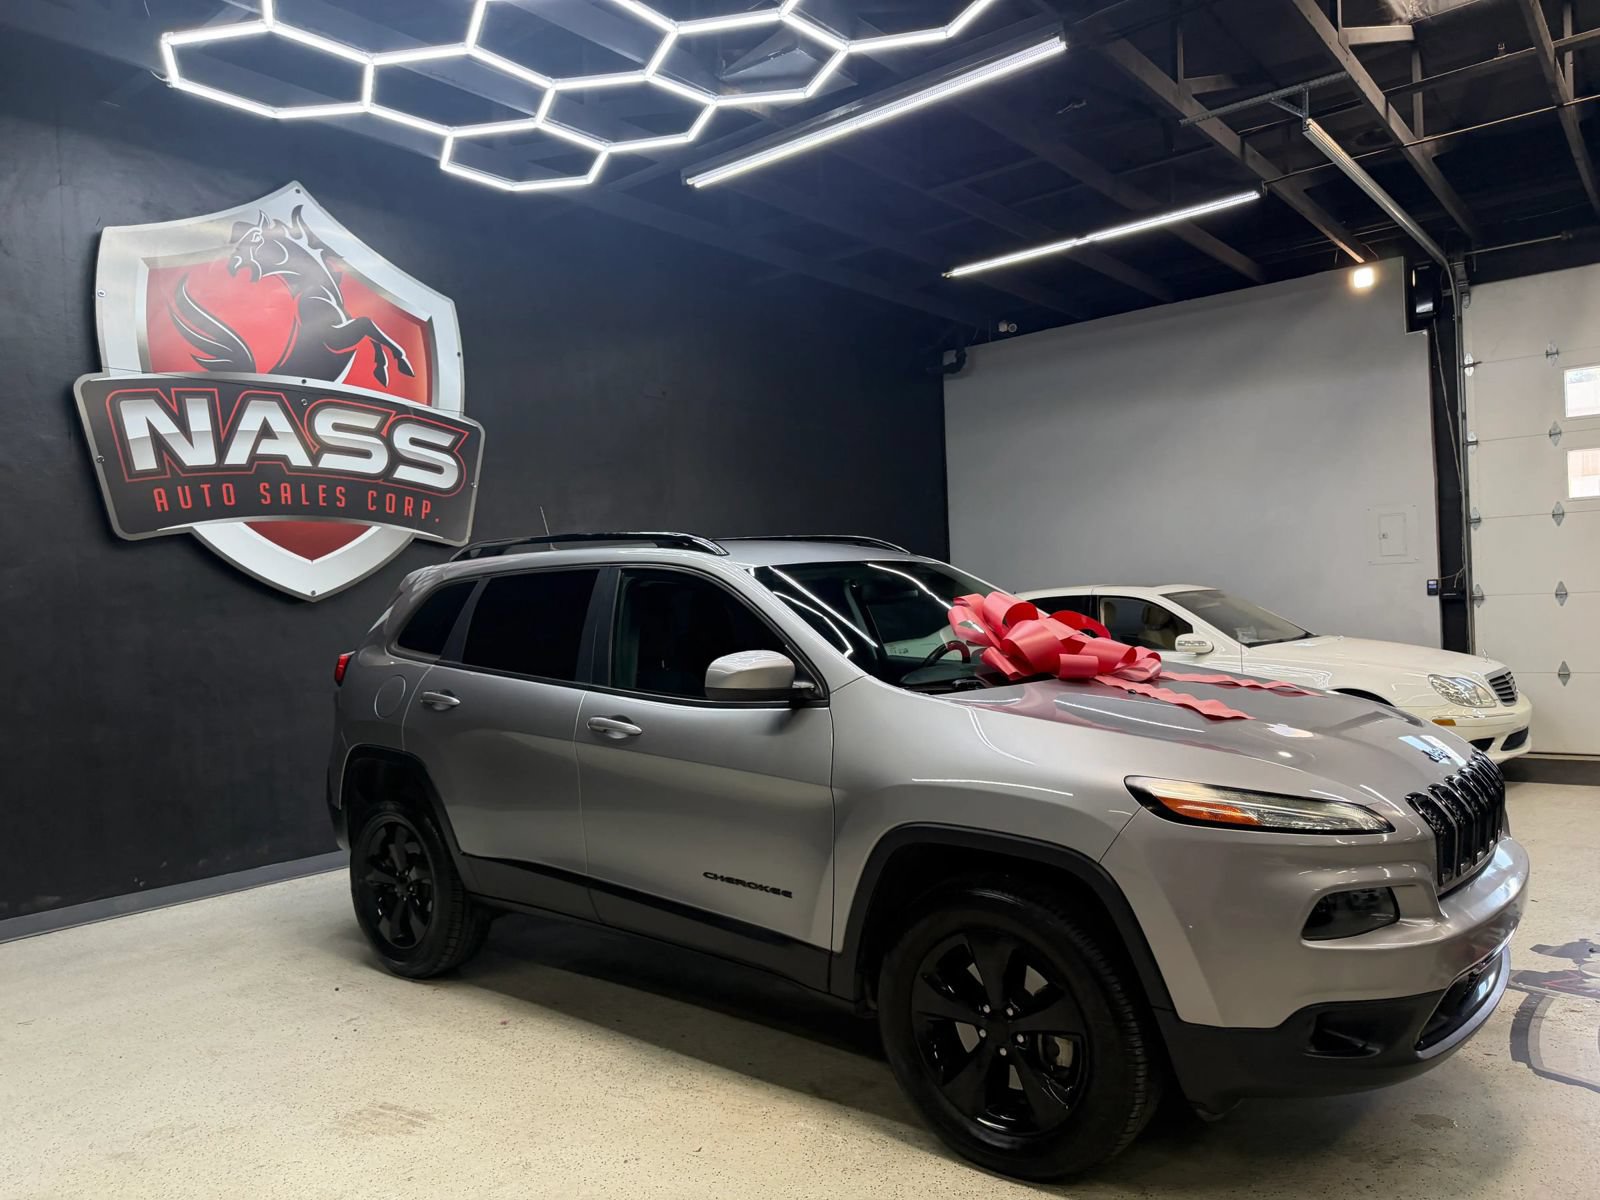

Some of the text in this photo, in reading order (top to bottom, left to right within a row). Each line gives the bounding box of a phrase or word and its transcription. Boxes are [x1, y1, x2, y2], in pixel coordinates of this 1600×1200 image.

[119, 398, 460, 490] NASS
[153, 483, 441, 523] AUTO SALES CORP.
[702, 871, 792, 899] CHEROKEE
